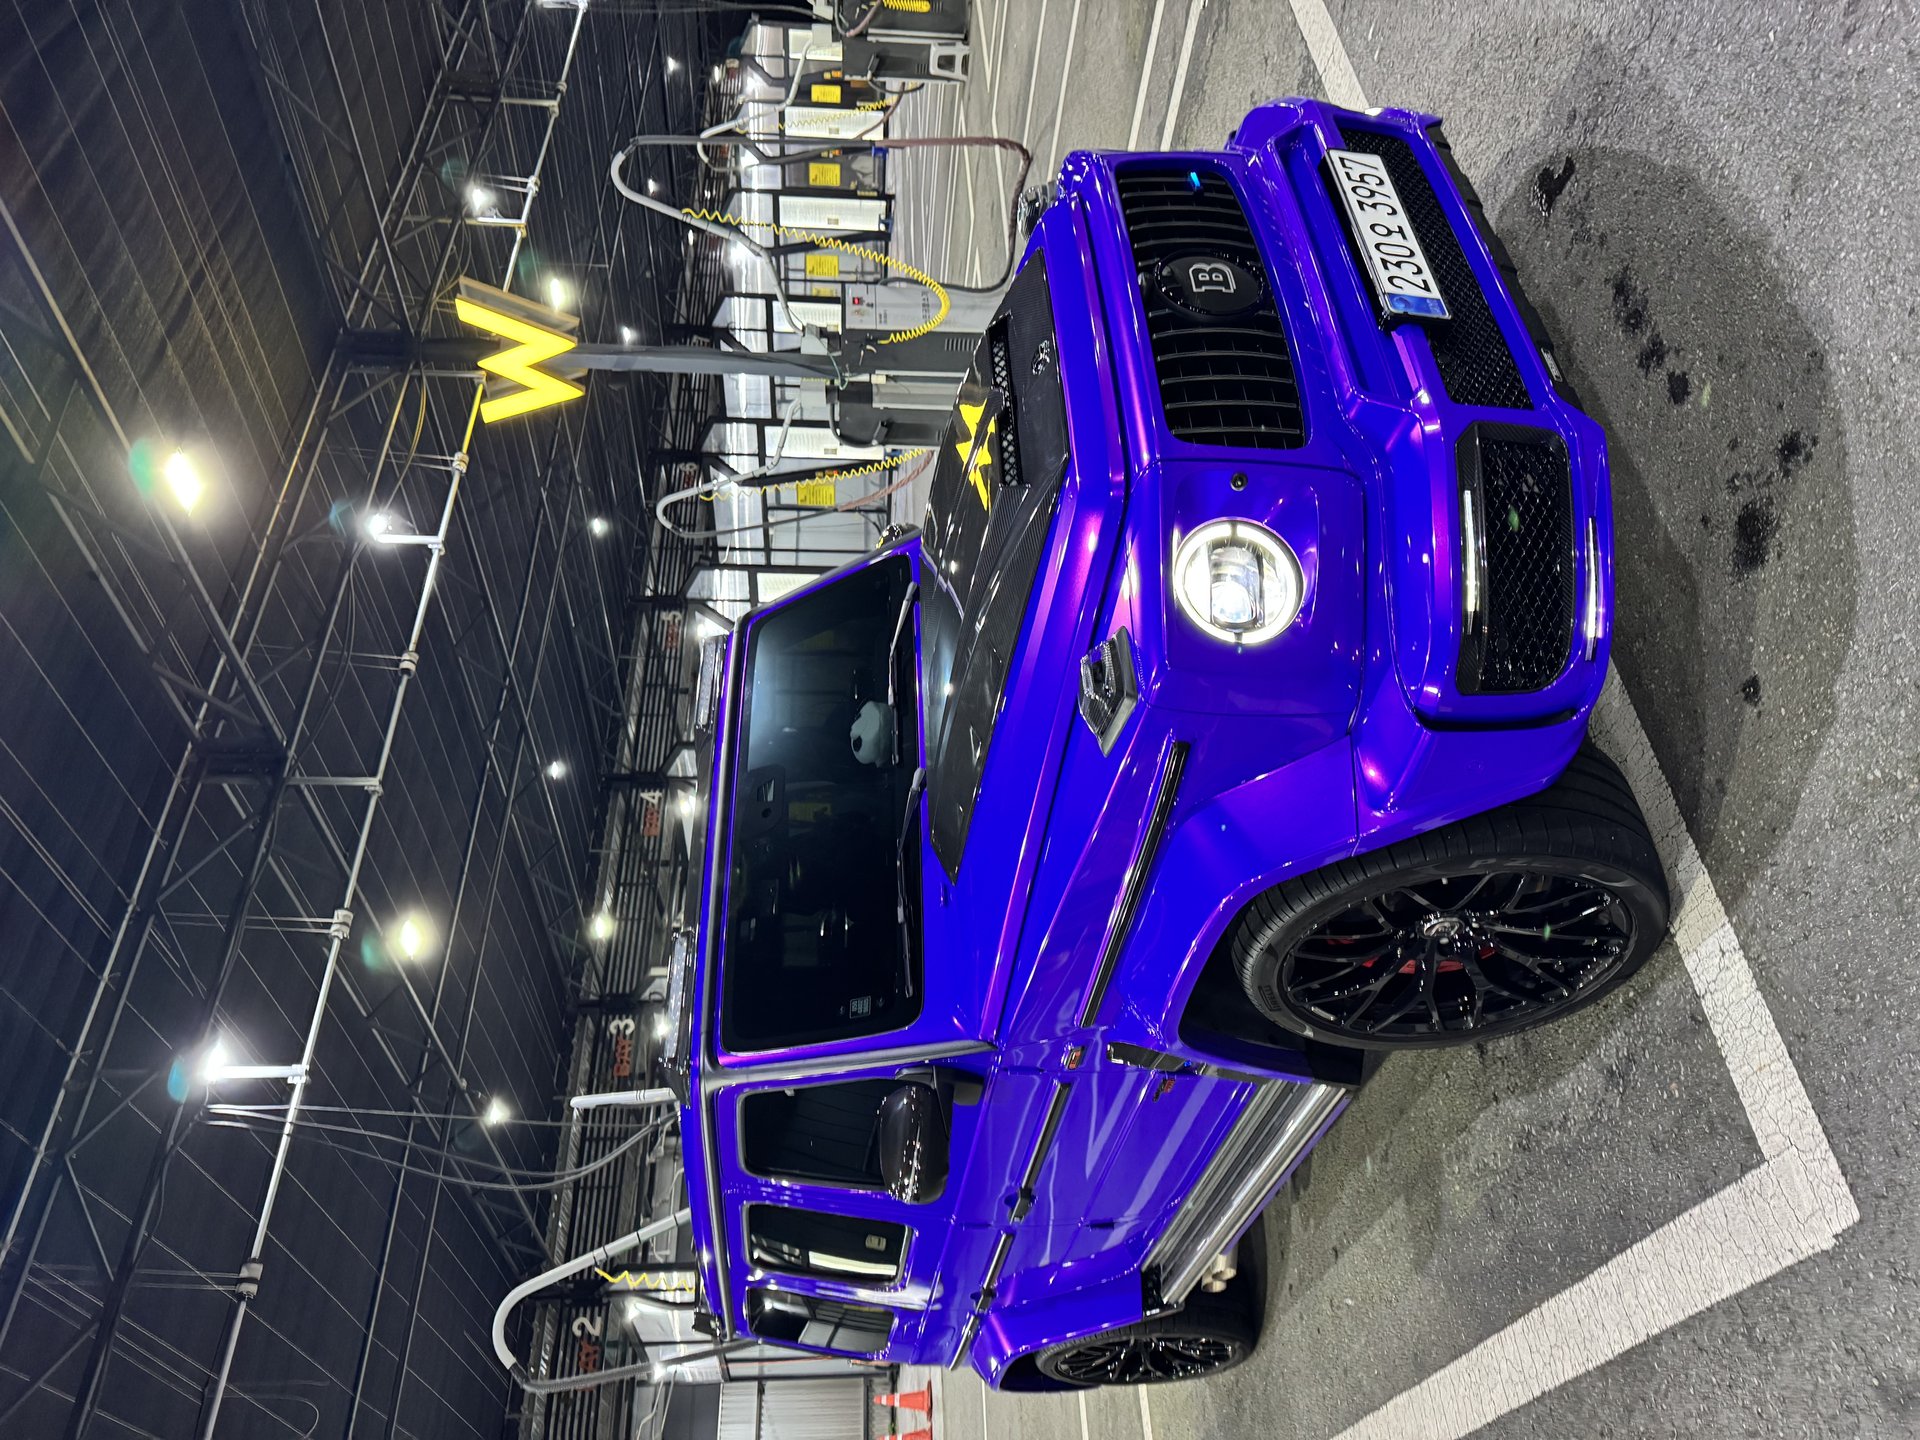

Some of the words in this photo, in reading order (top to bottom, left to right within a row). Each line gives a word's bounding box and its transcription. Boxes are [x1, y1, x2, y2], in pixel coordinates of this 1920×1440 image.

[1338, 156, 1398, 216] 3957
[1369, 222, 1432, 293] 230오
[1188, 261, 1237, 294] B
[454, 297, 586, 424] W
[660, 610, 682, 623] 5
[640, 790, 663, 805] 4
[609, 1018, 636, 1035] 3
[613, 1035, 634, 1078] BAY
[571, 1316, 602, 1337] 2
[576, 1341, 601, 1392] AY
